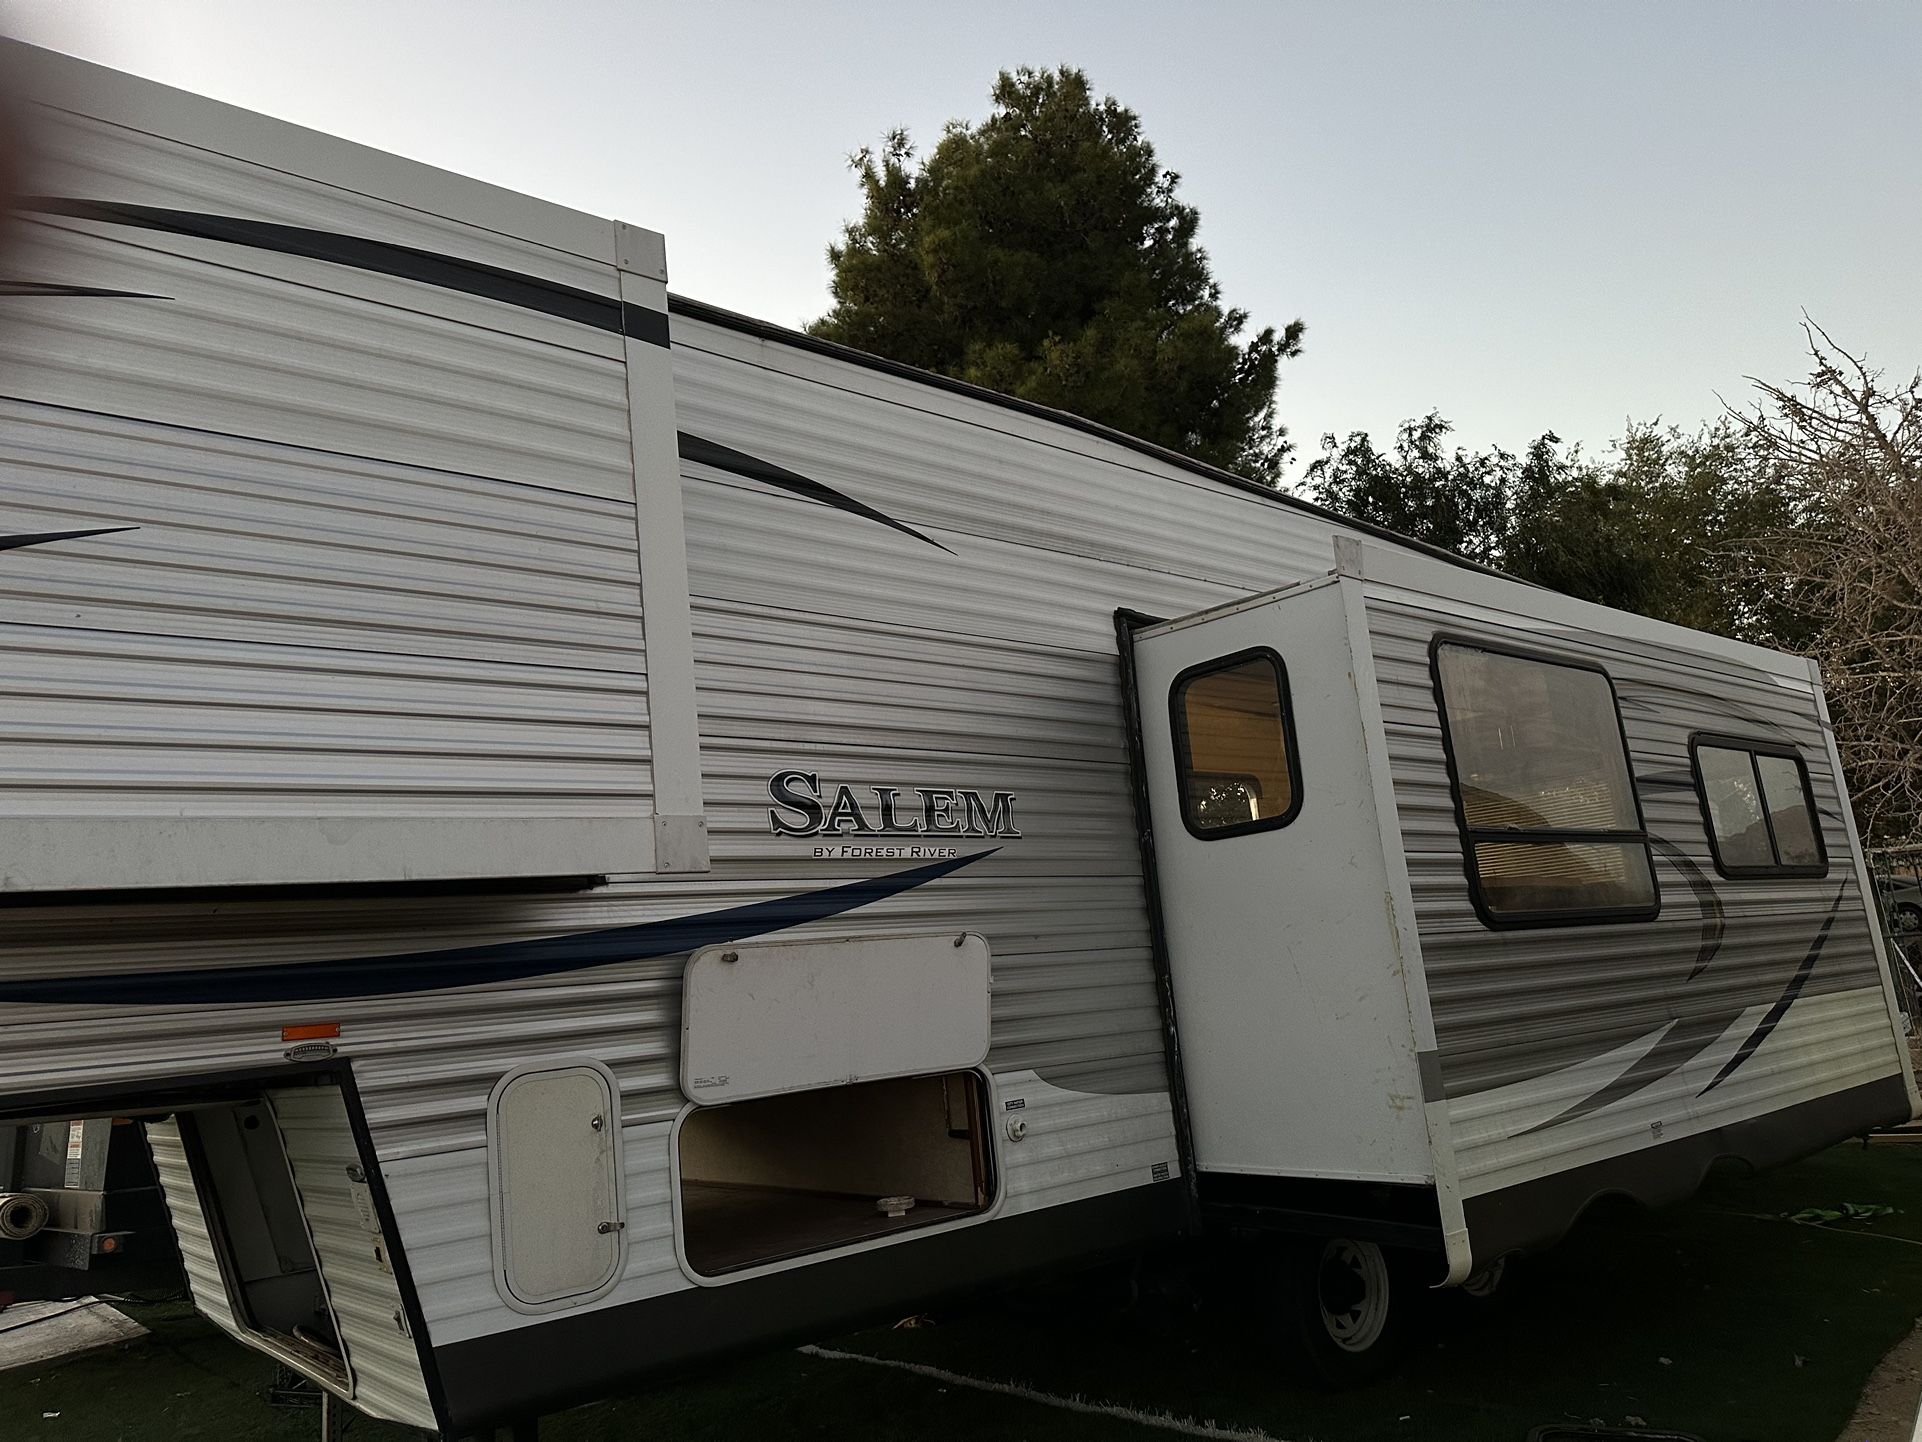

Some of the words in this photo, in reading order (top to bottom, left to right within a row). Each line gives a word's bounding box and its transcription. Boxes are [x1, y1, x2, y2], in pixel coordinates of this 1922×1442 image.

[767, 769, 1022, 838] SALEM
[813, 847, 835, 857] BY
[841, 845, 905, 857] FOREST
[911, 846, 957, 858] RIVER
